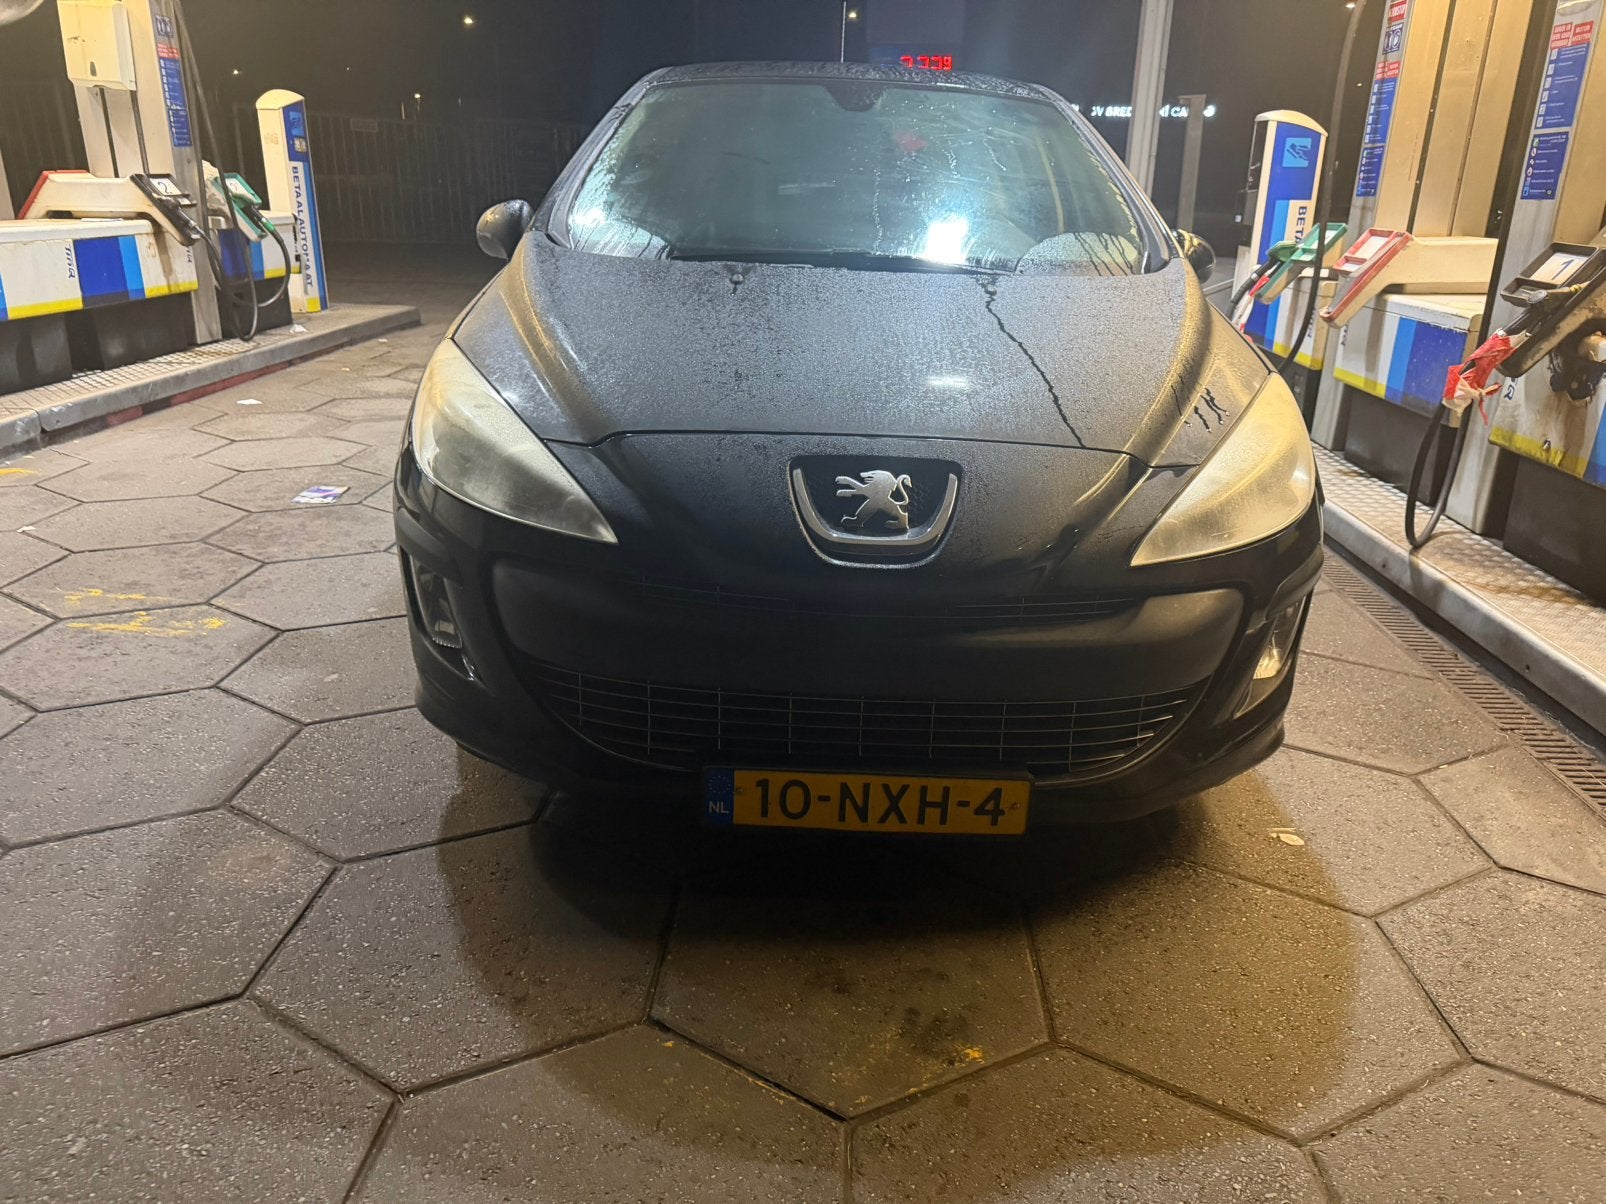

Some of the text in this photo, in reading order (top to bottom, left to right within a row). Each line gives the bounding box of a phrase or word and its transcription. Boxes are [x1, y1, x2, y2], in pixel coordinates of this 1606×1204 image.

[1551, 259, 1575, 281] 1
[708, 800, 729, 815] NL
[755, 778, 1006, 827] 10-NXH-4
